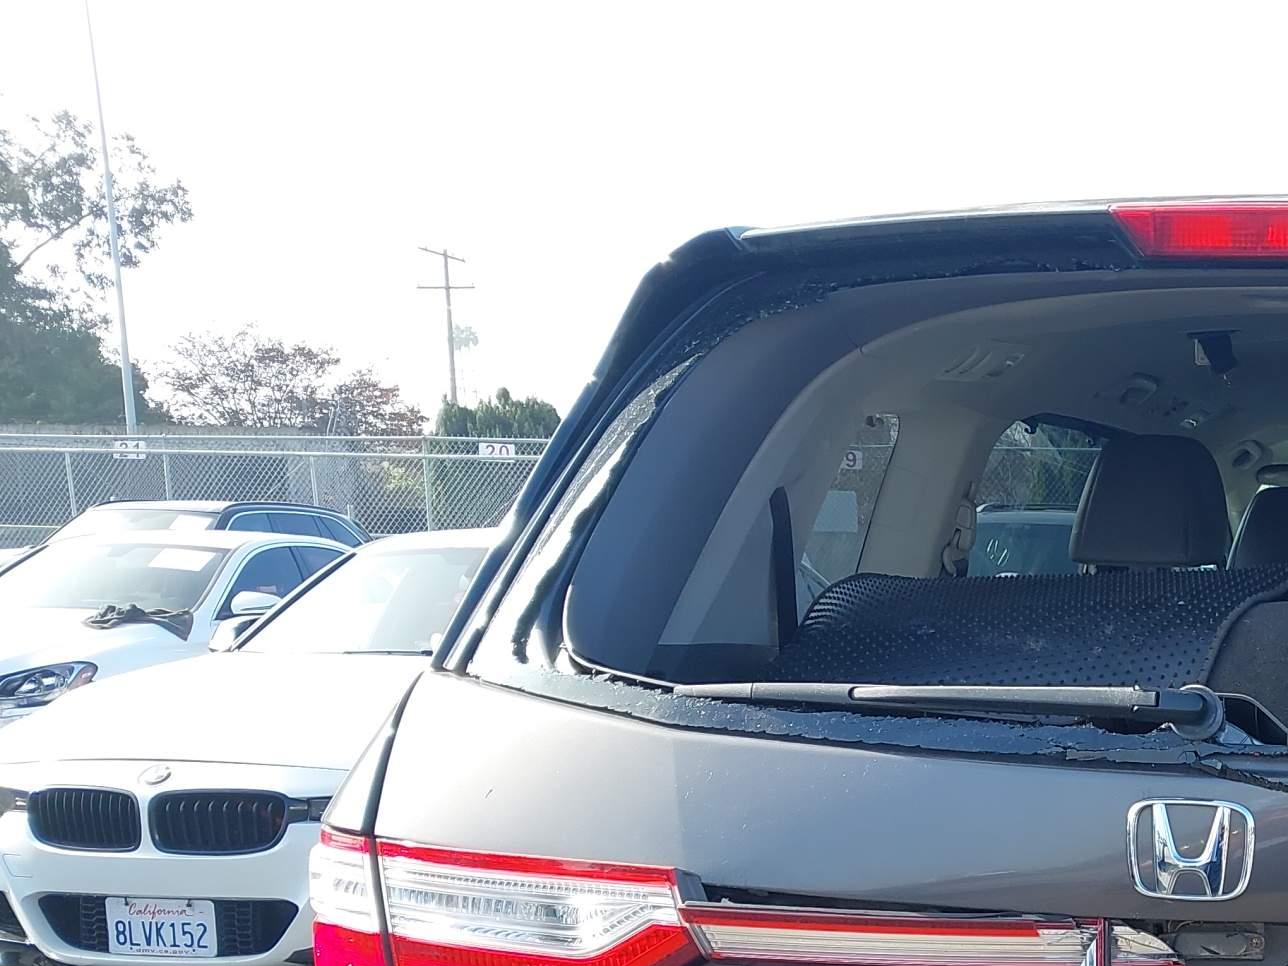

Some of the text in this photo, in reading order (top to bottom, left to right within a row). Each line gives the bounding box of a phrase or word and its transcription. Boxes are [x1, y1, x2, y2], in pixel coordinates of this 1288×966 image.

[119, 442, 139, 458] 21
[486, 444, 510, 457] 20
[128, 902, 194, 919] California
[114, 920, 209, 949] 8LVK152
